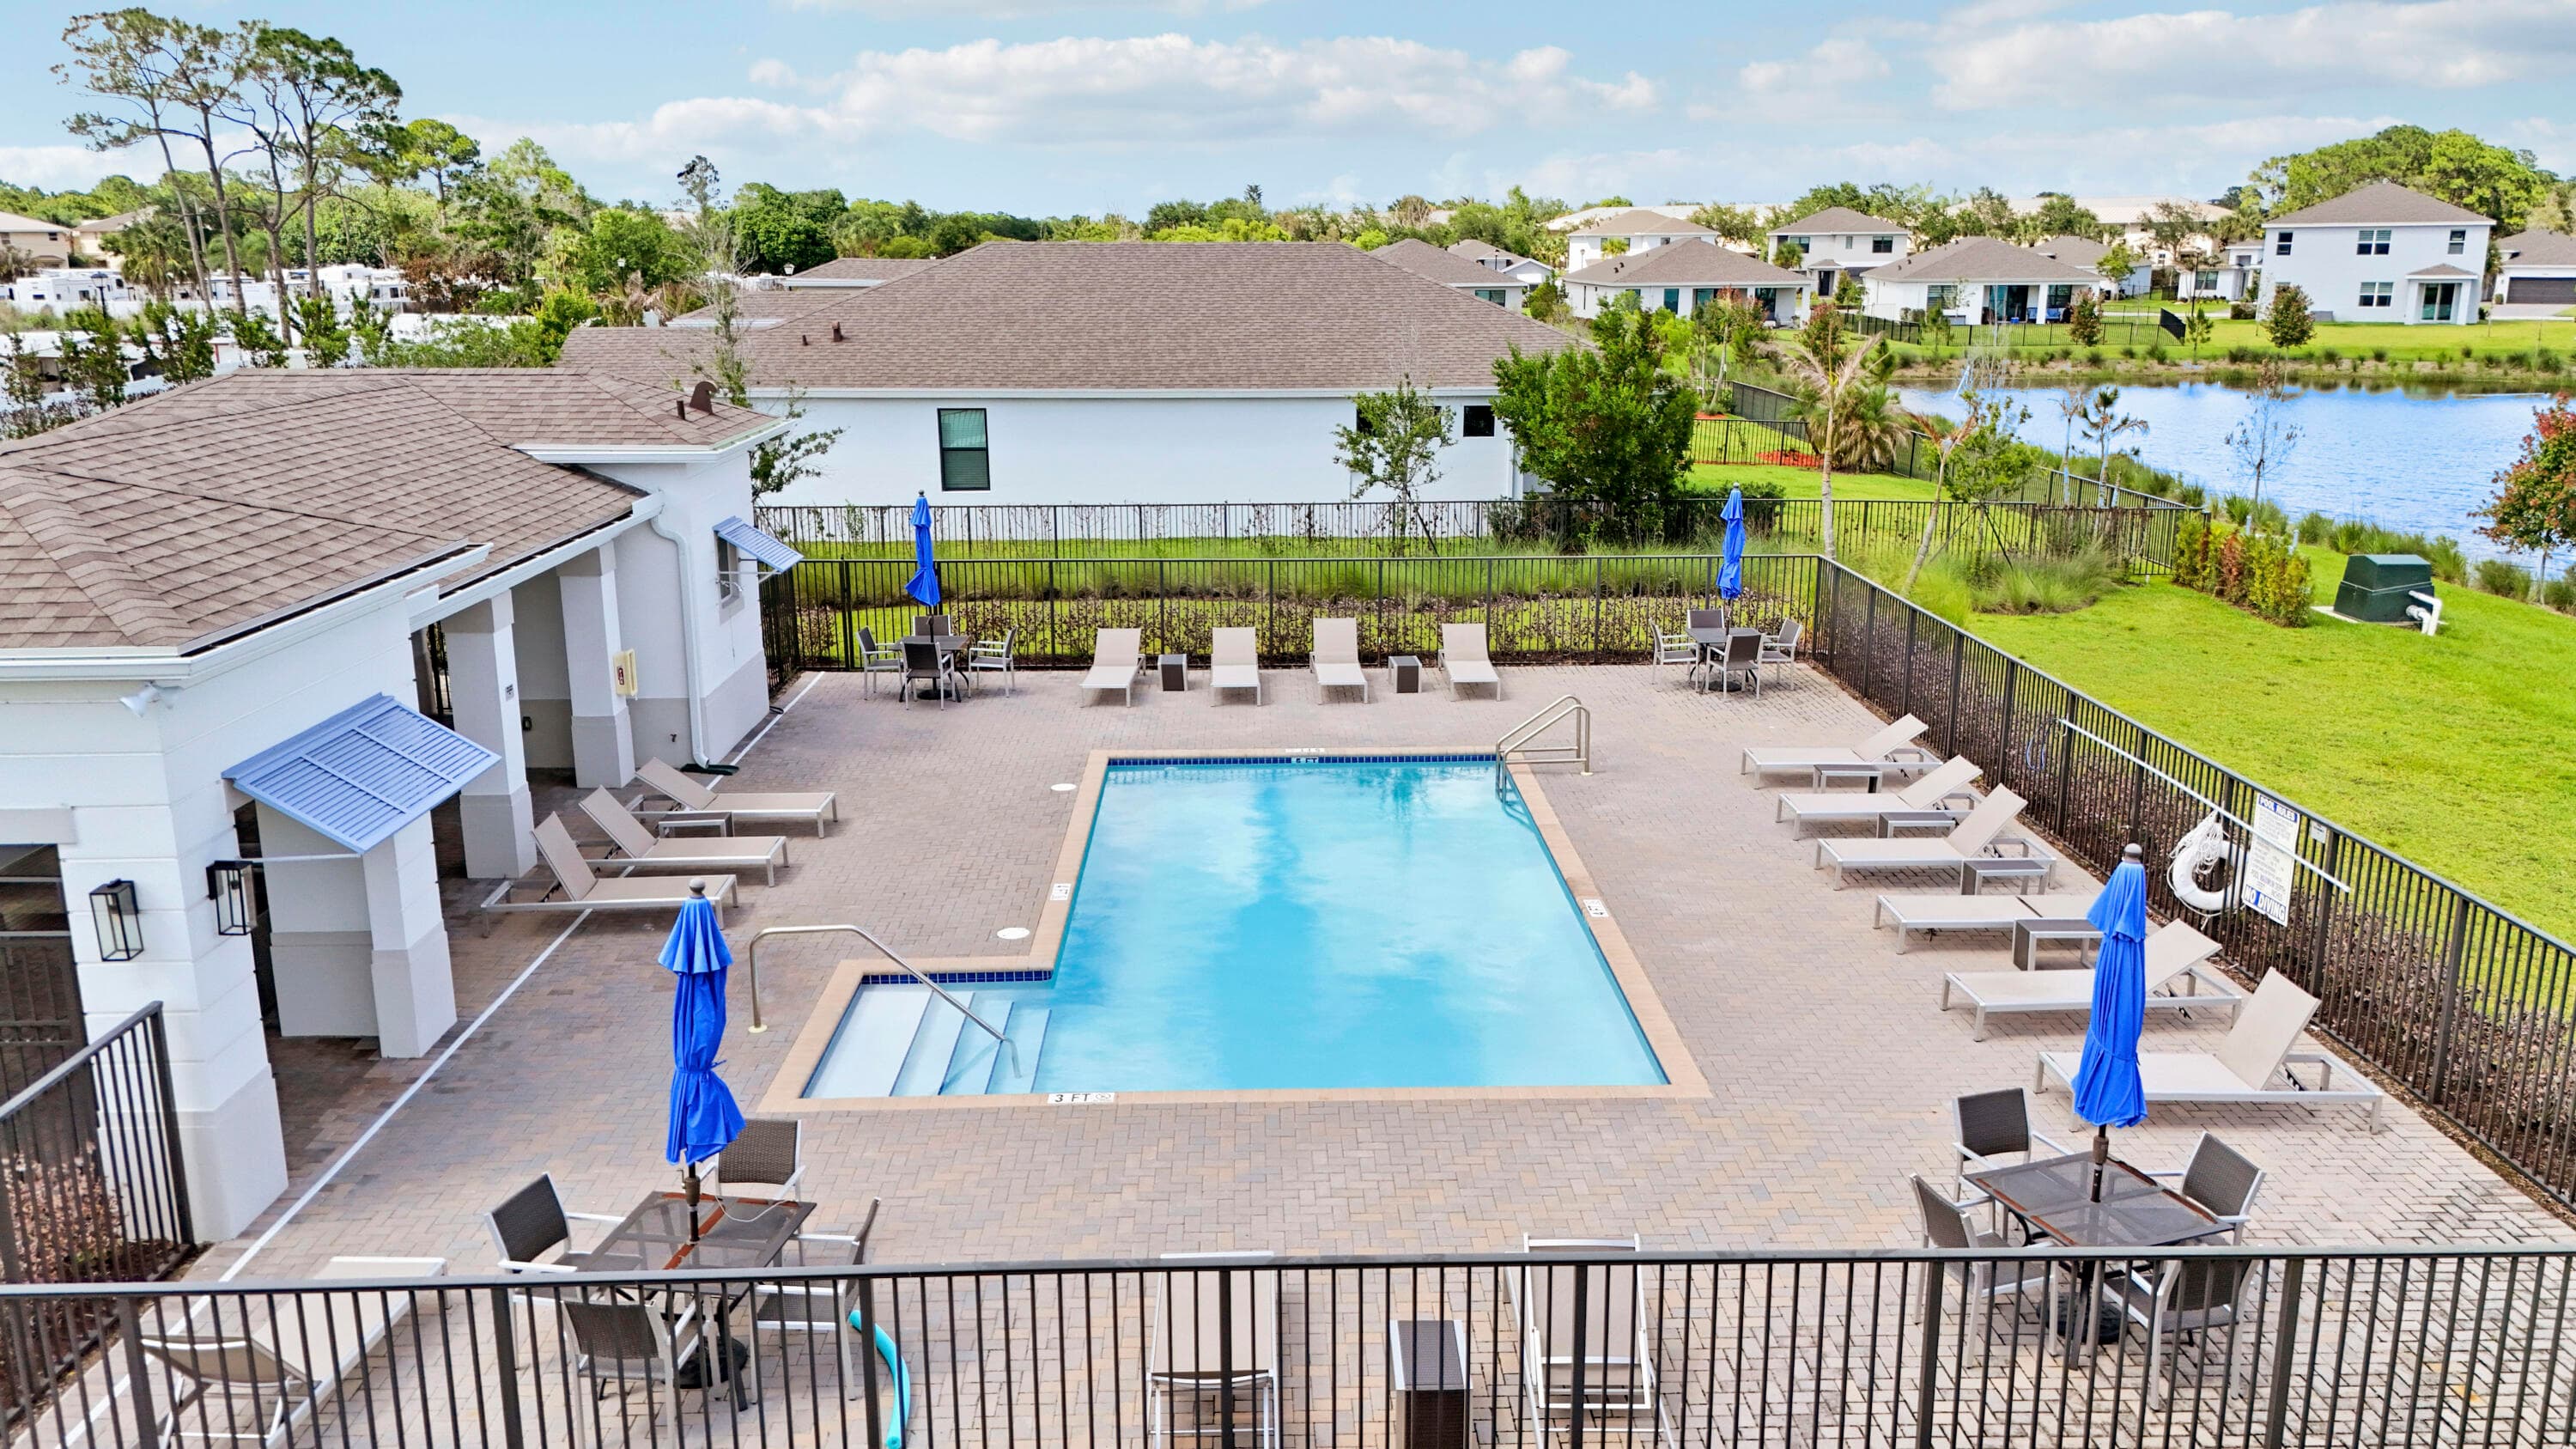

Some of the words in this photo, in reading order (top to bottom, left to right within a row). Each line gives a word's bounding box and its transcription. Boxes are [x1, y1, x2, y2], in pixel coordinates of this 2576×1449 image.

[2260, 796, 2275, 812] POOL
[2245, 886, 2257, 904] NO
[2257, 892, 2286, 922] DIVING
[1054, 1094, 1064, 1103] 3
[1071, 1093, 1091, 1102] FT
